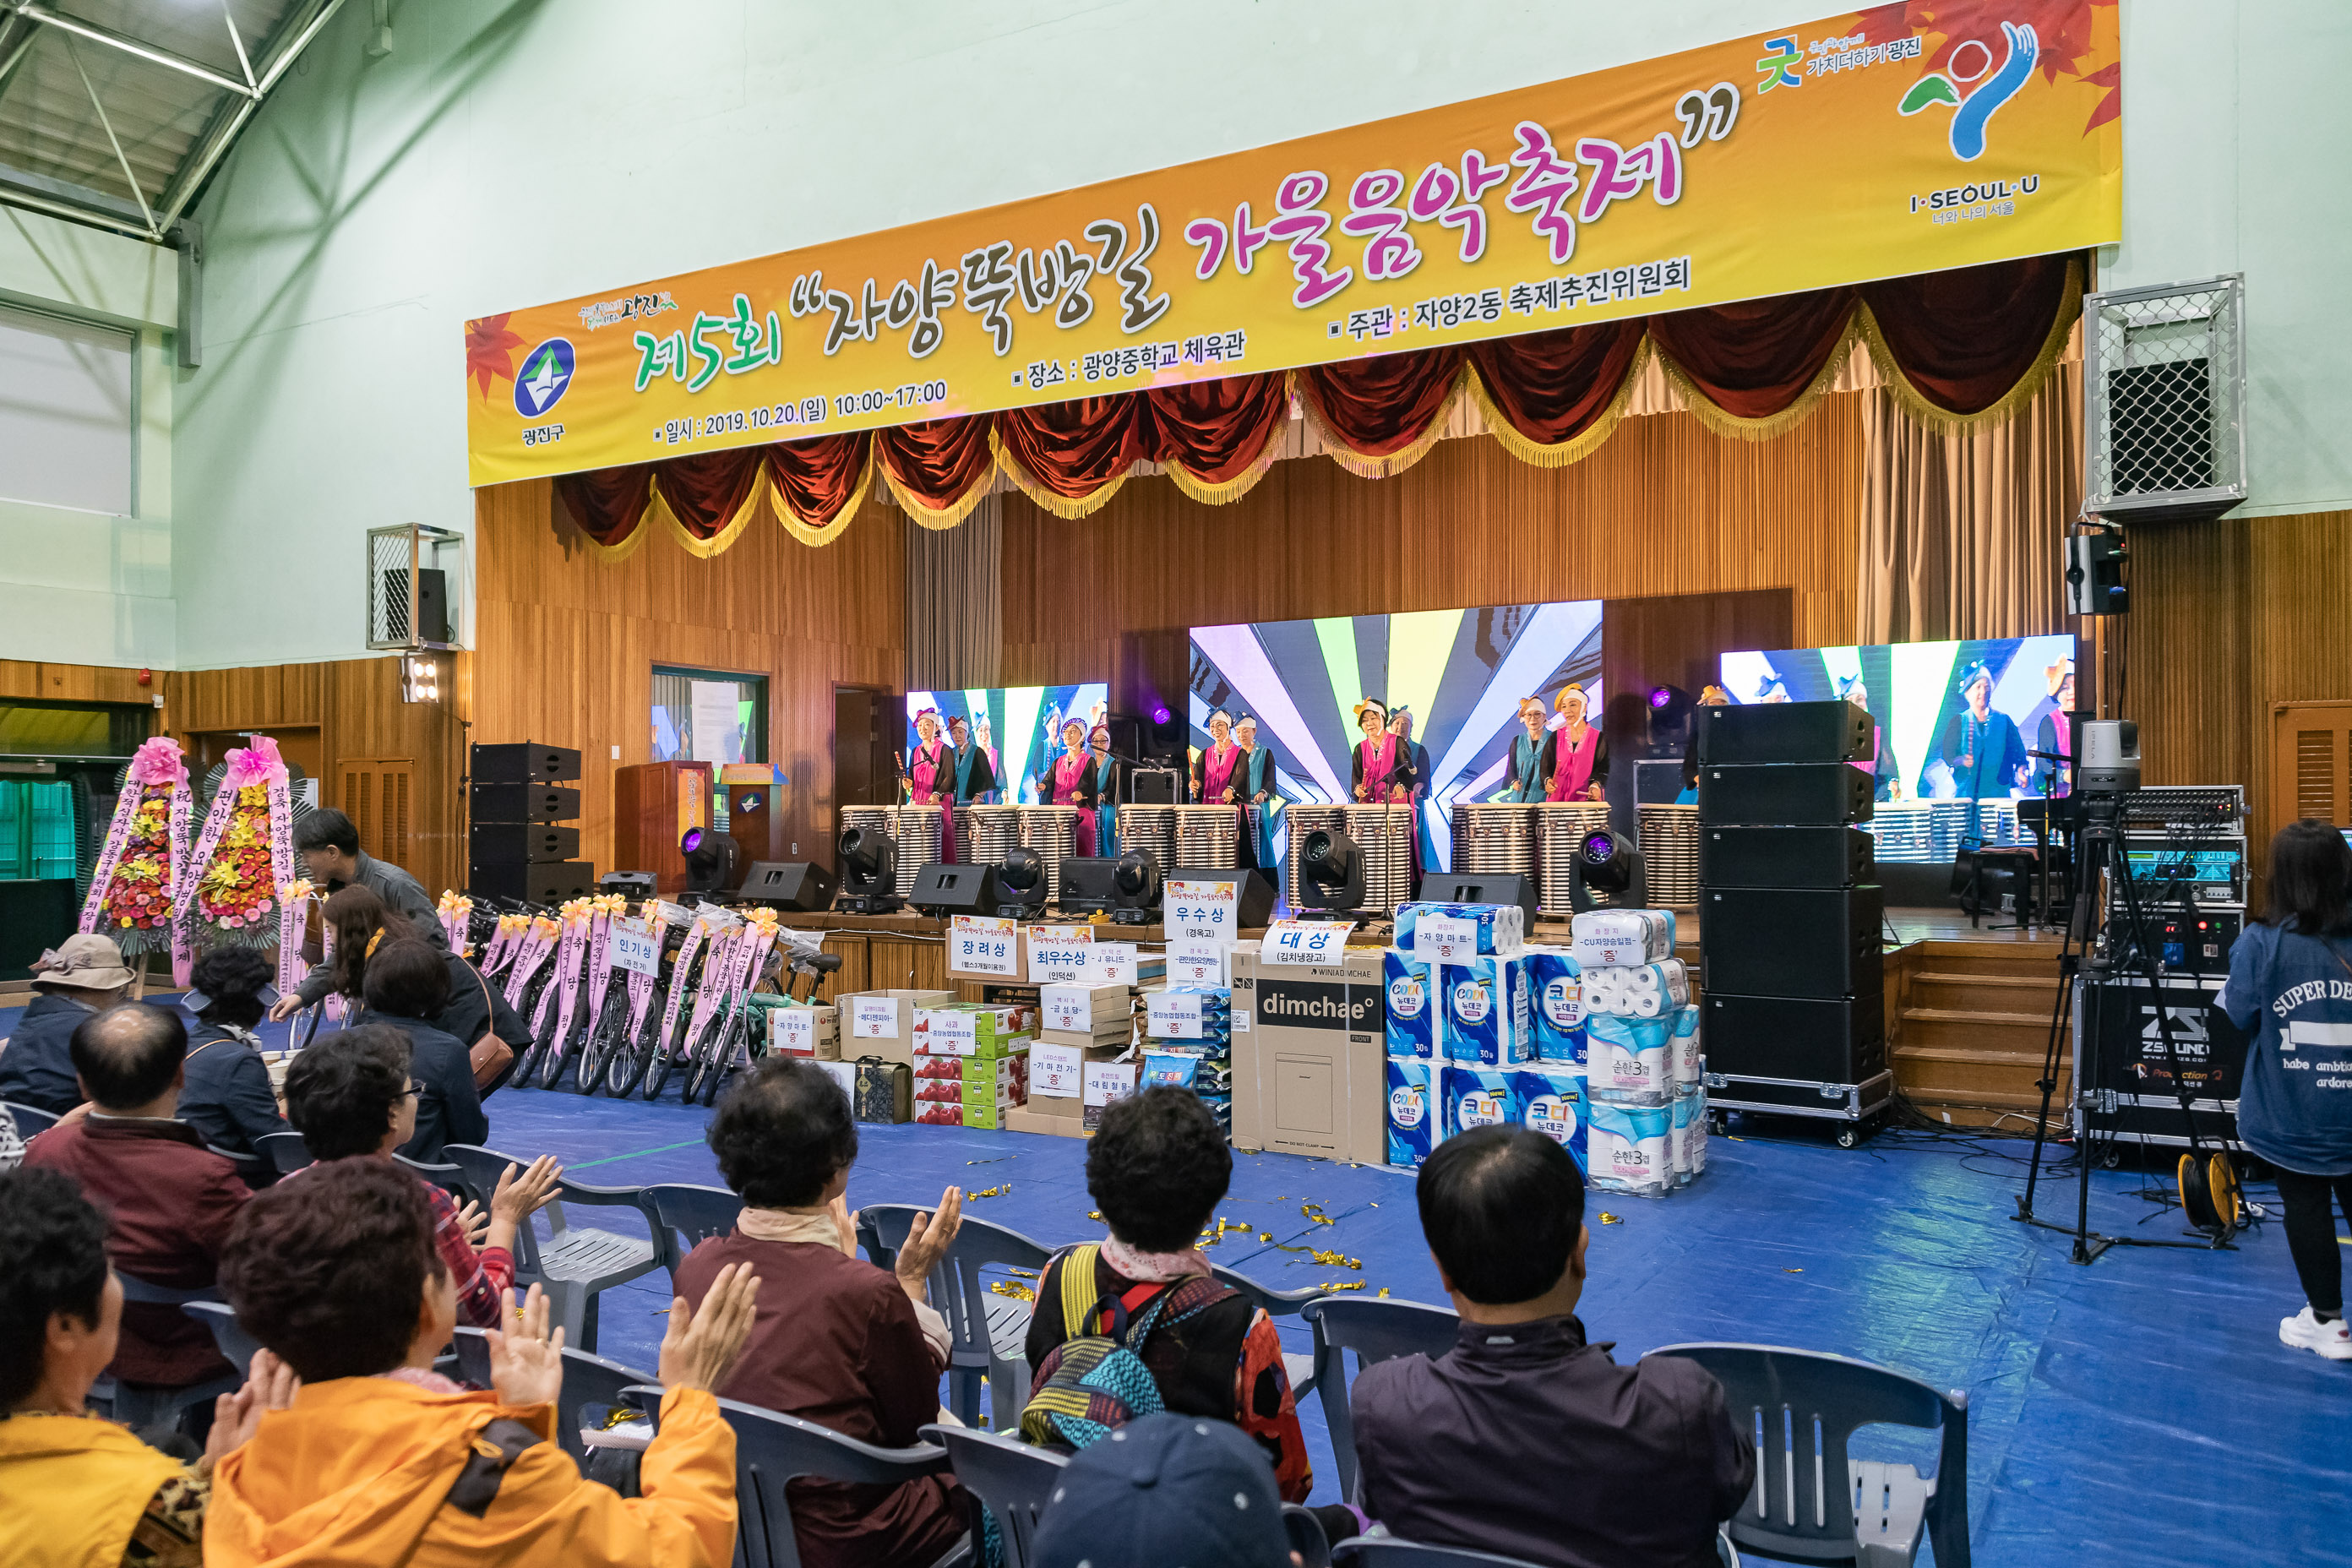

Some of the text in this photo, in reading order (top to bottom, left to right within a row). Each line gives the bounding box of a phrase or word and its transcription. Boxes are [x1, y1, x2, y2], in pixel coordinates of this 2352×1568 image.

[1807, 35, 1921, 76] 가치더하기 광진
[1932, 200, 2015, 226] 너와 나의 서울
[1348, 305, 1392, 342] 주관
[1415, 286, 1503, 328] 자양2동
[1508, 256, 1691, 313] 축제추진위원회
[632, 292, 782, 395] 제5회
[1027, 360, 1065, 389] 장소
[1081, 345, 1179, 380] 광양중학교
[1183, 330, 1246, 364] 체육관
[521, 423, 567, 447] 광진구
[665, 422, 694, 444] 일시
[272, 786, 287, 808] 경축
[204, 790, 233, 843] 편안한
[1176, 906, 1224, 923] 우수상
[1185, 928, 1215, 939] (경옥고)
[1279, 932, 1331, 950] 대상
[619, 939, 651, 959] 인기상
[962, 939, 1006, 957] 장려상
[1037, 950, 1086, 966] 최우수상
[1277, 952, 1326, 963] (김치냉장고)
[1048, 971, 1076, 982] (인덕션)
[1392, 983, 1419, 995] CODI
[1456, 988, 1484, 999] CODI
[1549, 984, 1582, 1001] 코디
[1396, 997, 1417, 1005] 뉴데코
[1462, 1002, 1482, 1010] 뉴데코
[2272, 979, 2328, 1018] SUPER
[1554, 1002, 1579, 1012] 뉴데코
[945, 1021, 958, 1029] 사과
[1612, 1061, 1649, 1075] 순한3겹
[2282, 1058, 2311, 1070] habe
[1392, 1093, 1418, 1106] CODI
[1489, 1088, 1505, 1097] New!
[1560, 1092, 1578, 1102] New!
[1397, 1107, 1416, 1115] 뉴데코
[1464, 1098, 1496, 1116] 코디
[1532, 1102, 1568, 1120] 코디
[1537, 1122, 1564, 1132] 뉴데코
[1612, 1150, 1649, 1164] 순한3겹
